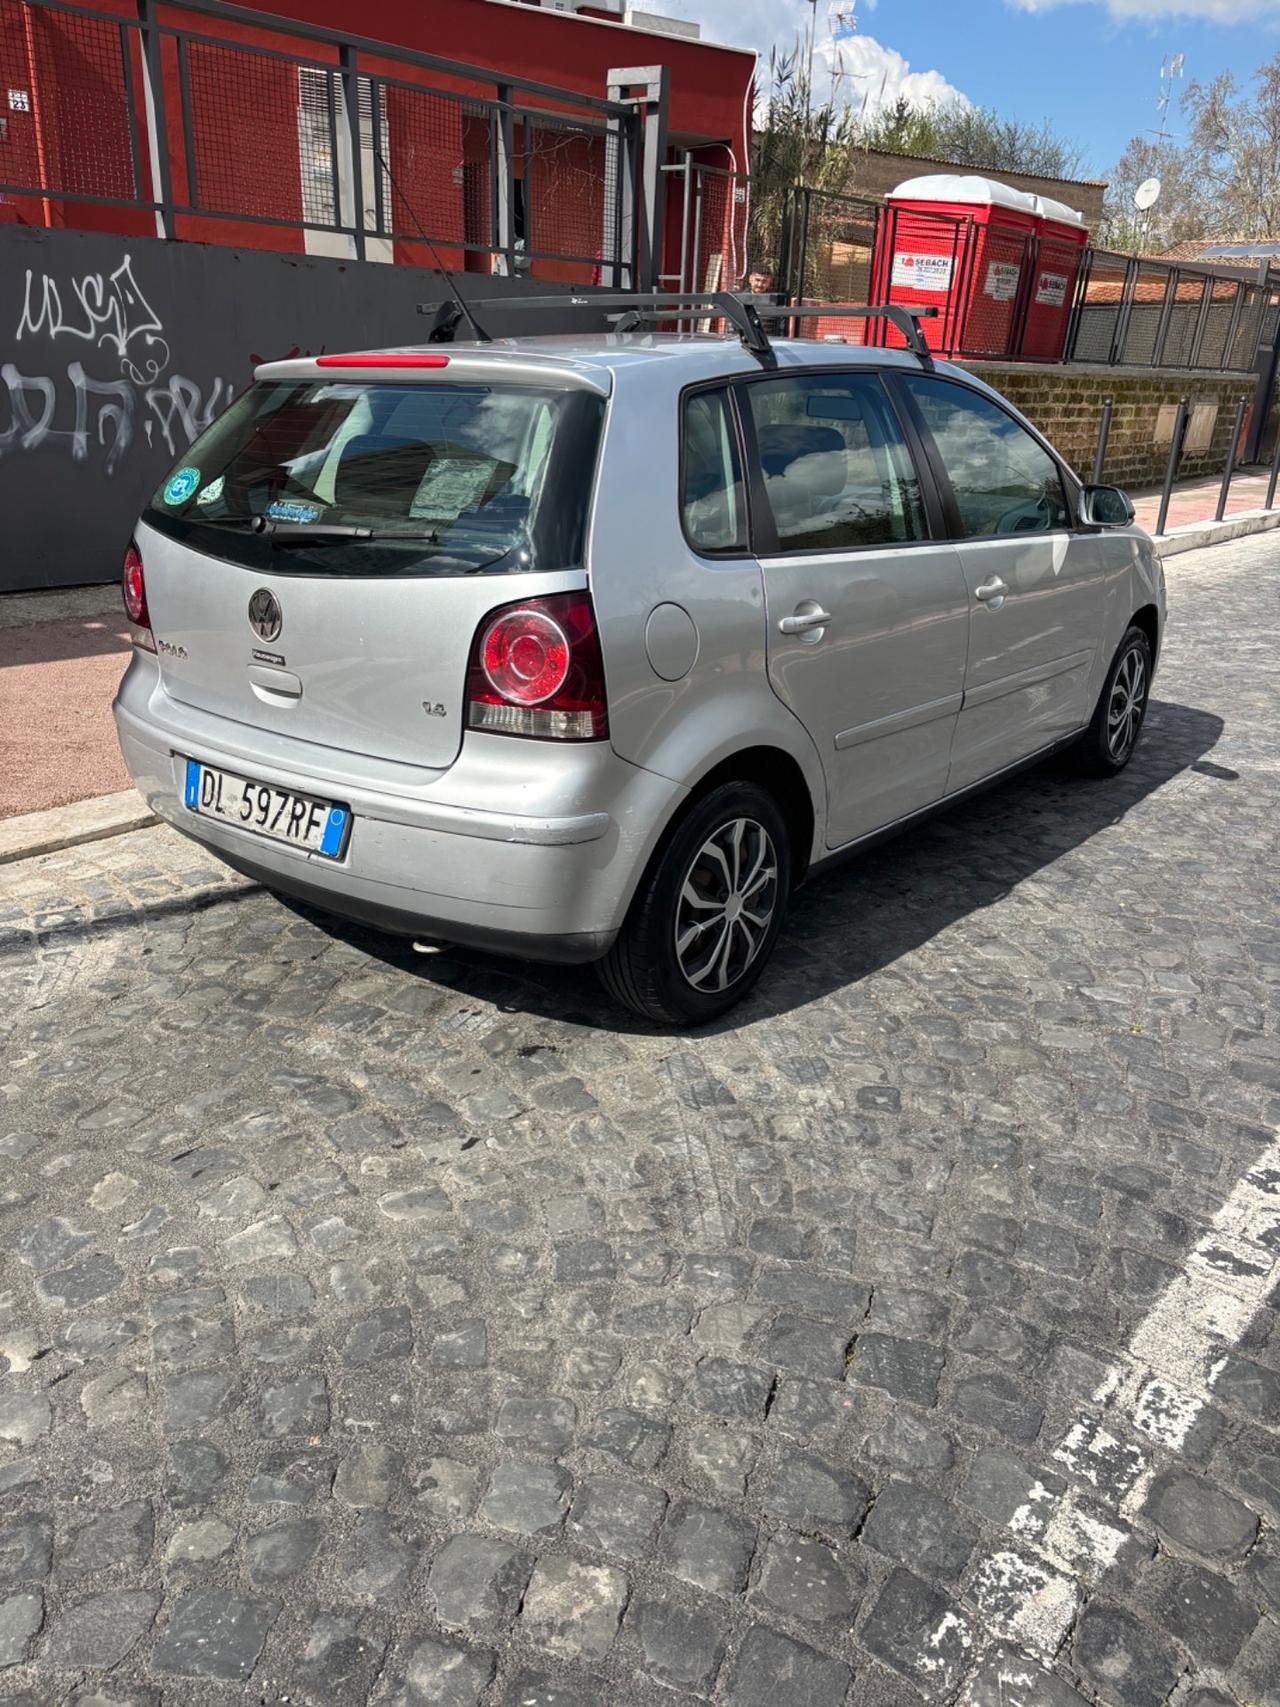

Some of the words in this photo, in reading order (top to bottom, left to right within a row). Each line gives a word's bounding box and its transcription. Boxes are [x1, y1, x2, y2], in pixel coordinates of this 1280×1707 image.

[12, 100, 26, 110] 23
[915, 258, 949, 267] SEBACH
[202, 770, 225, 815] DL
[240, 783, 326, 841] 597RF
